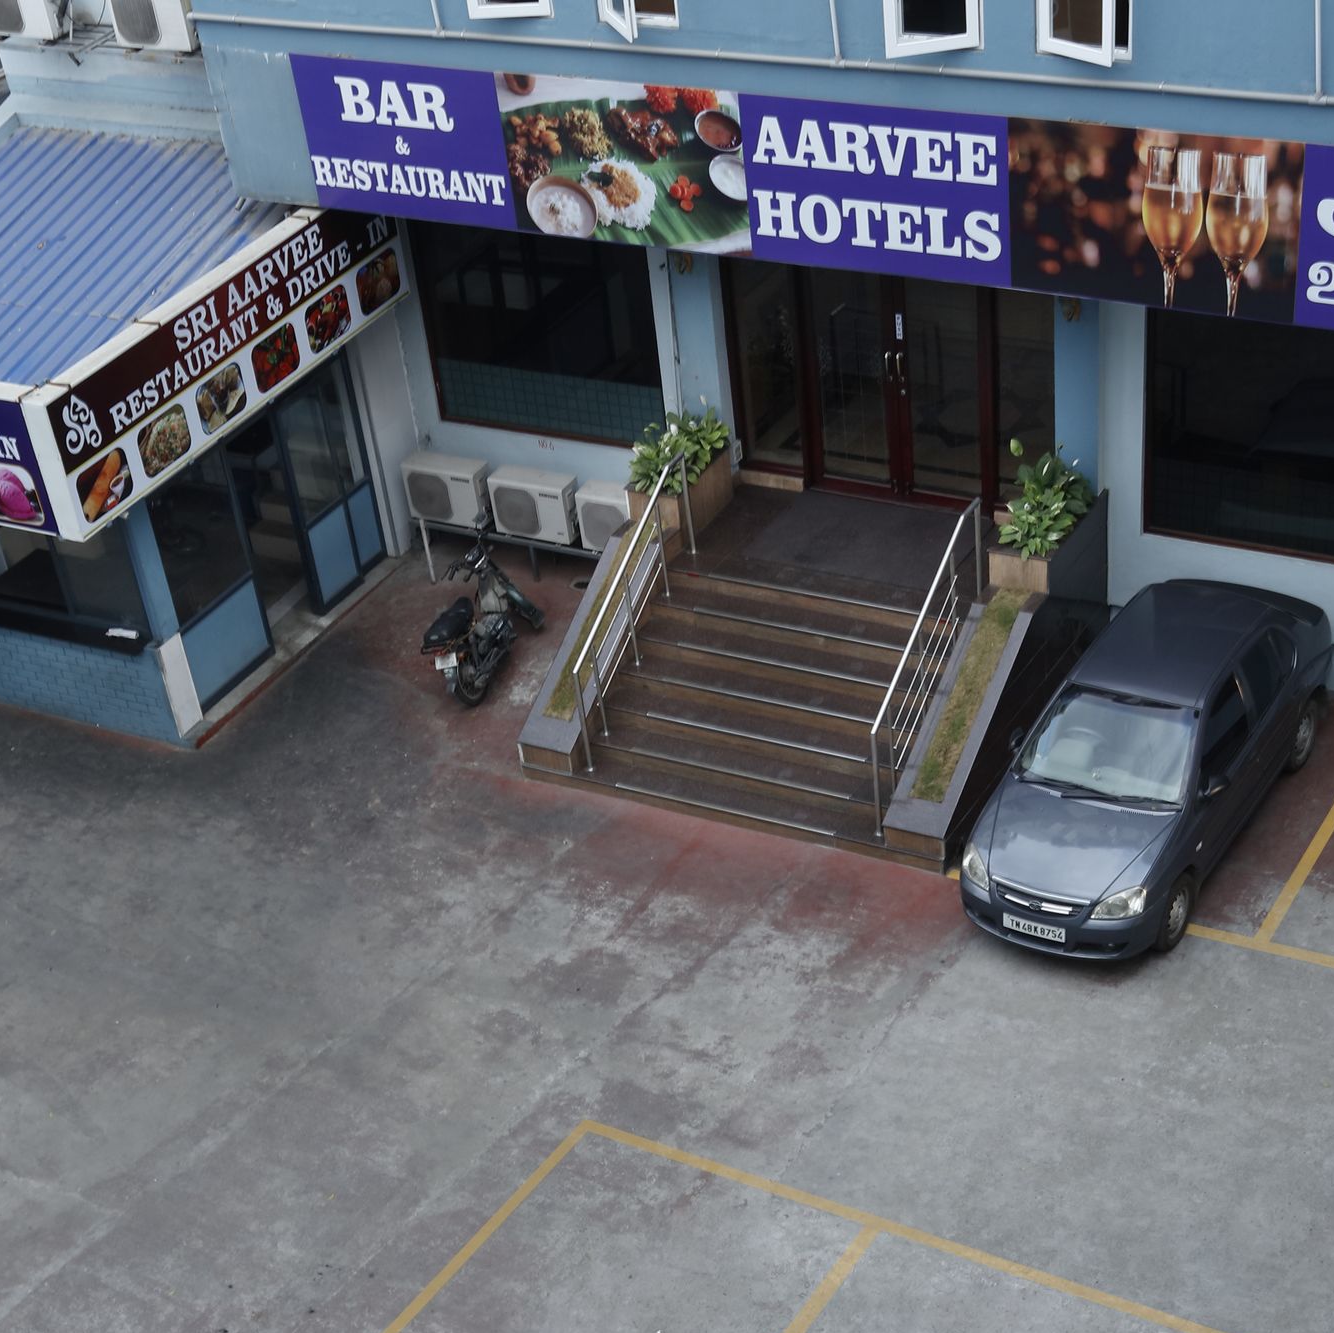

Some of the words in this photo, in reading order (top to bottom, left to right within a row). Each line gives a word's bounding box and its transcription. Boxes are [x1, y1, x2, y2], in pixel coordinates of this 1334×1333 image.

[333, 75, 454, 133] BAR
[311, 155, 507, 208] RESTAURANT
[395, 135, 411, 157] &
[752, 115, 998, 187] AARVEE
[752, 188, 1002, 263] HOTELS
[173, 298, 221, 353] SRI
[227, 224, 324, 317] AARVEE
[109, 307, 260, 434] RESTAURANT
[266, 294, 284, 321] &
[286, 240, 352, 309] DRIVE
[368, 217, 390, 249] IN
